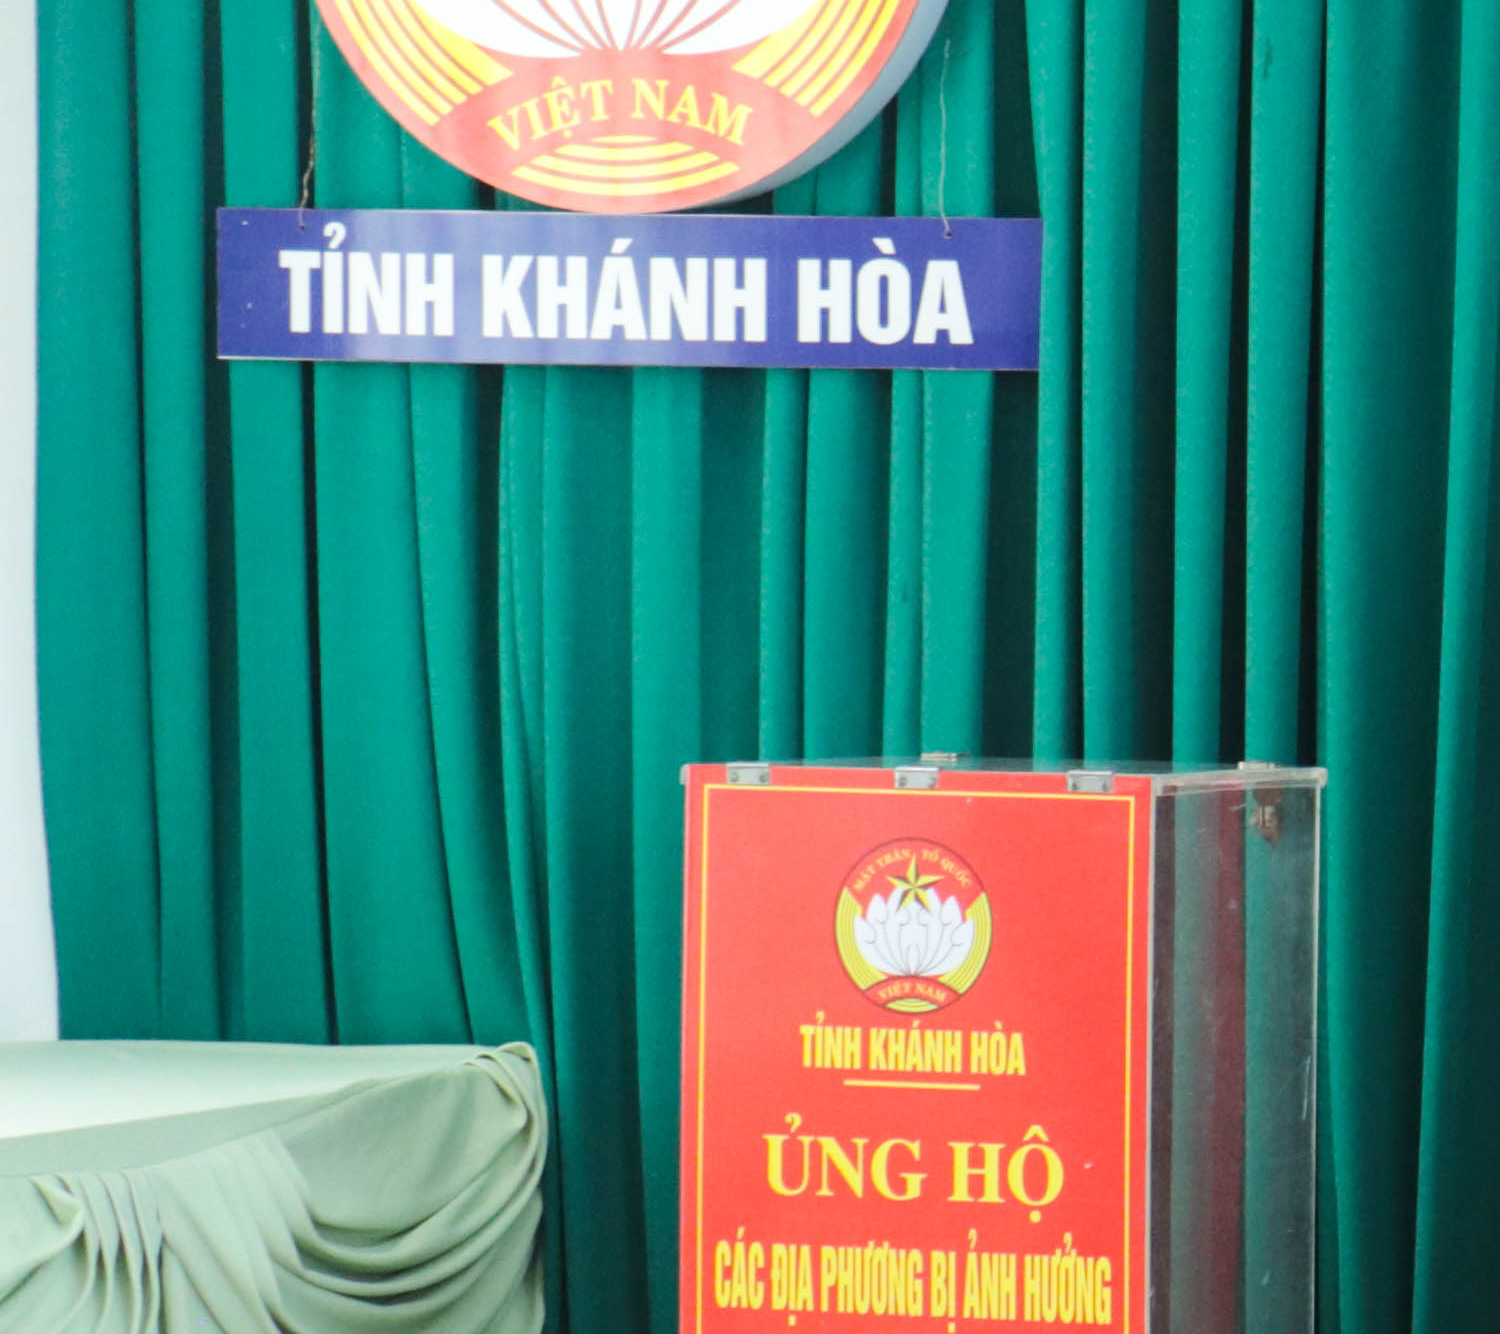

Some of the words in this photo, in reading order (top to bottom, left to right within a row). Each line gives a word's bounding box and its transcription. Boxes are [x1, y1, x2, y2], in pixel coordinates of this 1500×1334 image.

[487, 78, 613, 154] VIỆT
[630, 79, 754, 146] NAM
[279, 222, 453, 338] TỈNH
[482, 238, 767, 342] KHÁNH
[796, 238, 974, 345] HÒA
[800, 1011, 860, 1070] TỈNH
[869, 1021, 963, 1073] KHÁNH
[970, 1021, 1026, 1077] HÒA
[762, 1112, 928, 1201] ỦNG
[947, 1123, 1065, 1223] HỘ
[714, 1227, 765, 1309] CÁC
[771, 1243, 813, 1326] ĐỊA
[820, 1242, 924, 1319] PHƯƠNG
[930, 1249, 957, 1334] BỊ
[963, 1228, 1017, 1321] ẢNH
[1023, 1231, 1111, 1325] HƯỞNG
